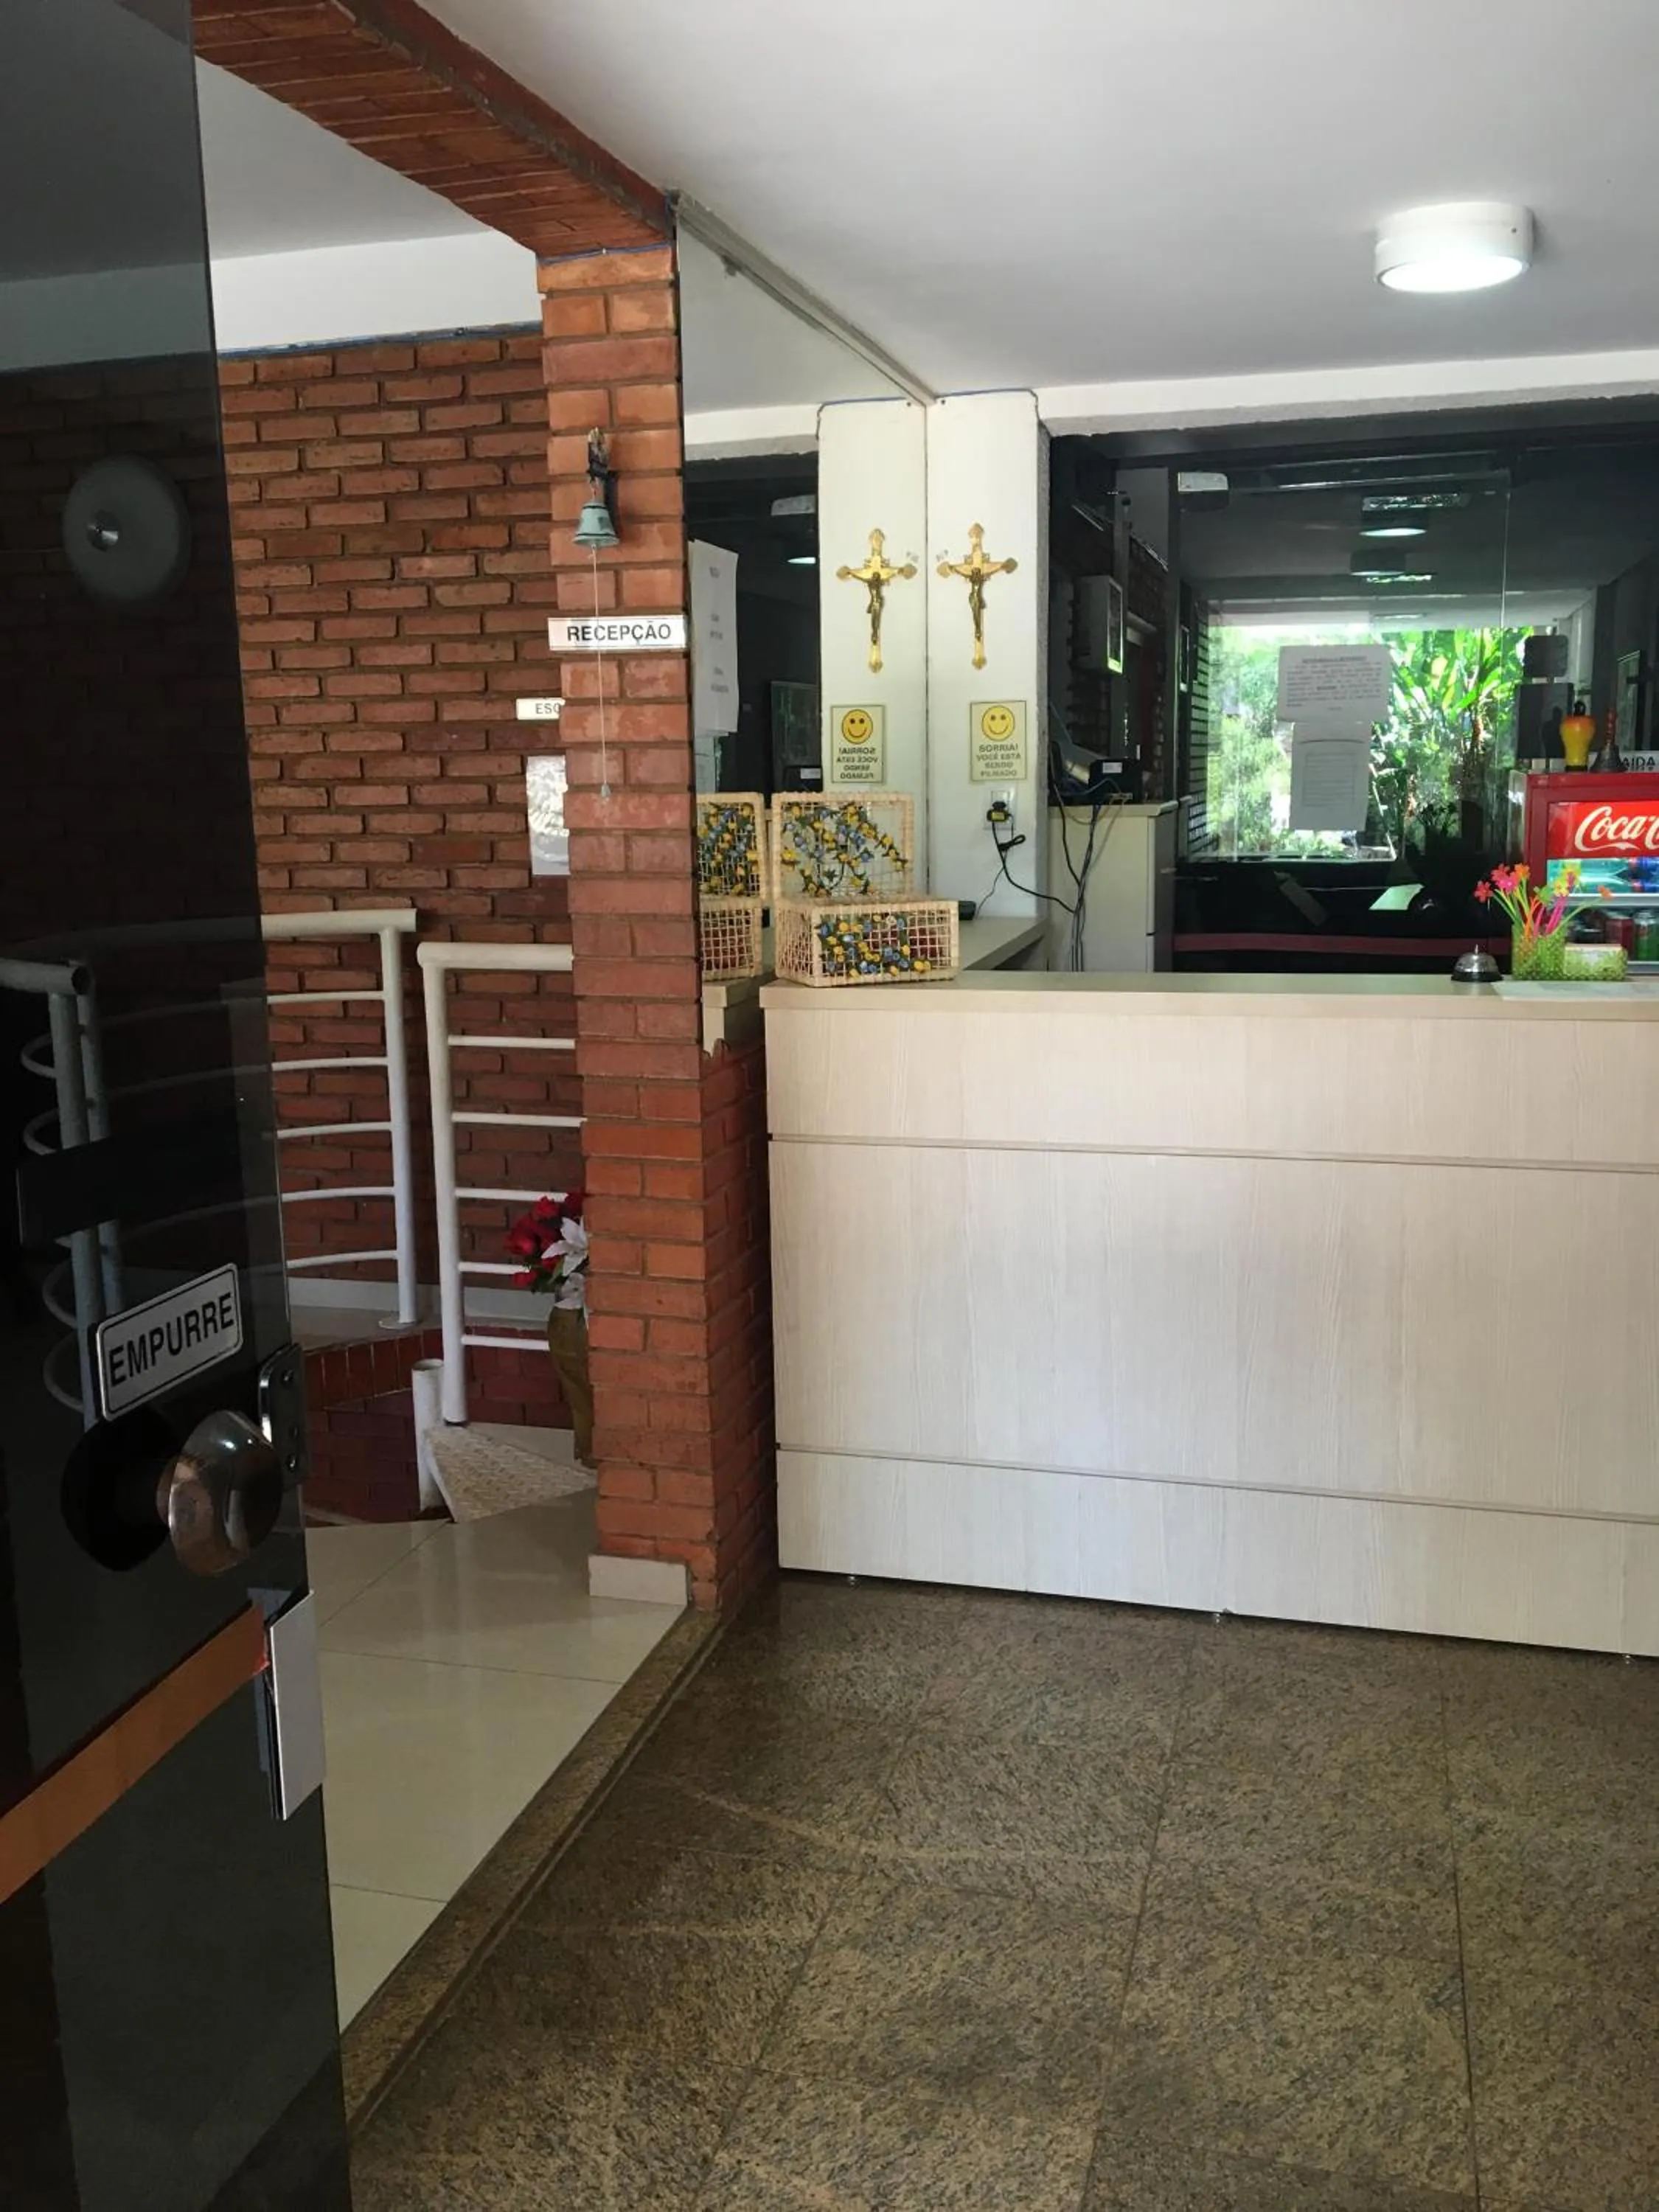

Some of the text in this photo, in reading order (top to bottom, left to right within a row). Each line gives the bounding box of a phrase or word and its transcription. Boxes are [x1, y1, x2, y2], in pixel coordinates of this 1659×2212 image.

[567, 620, 671, 645] RECEPÇÃO
[1622, 756, 1655, 767] AIDA
[108, 1293, 234, 1386] EMPURRE
